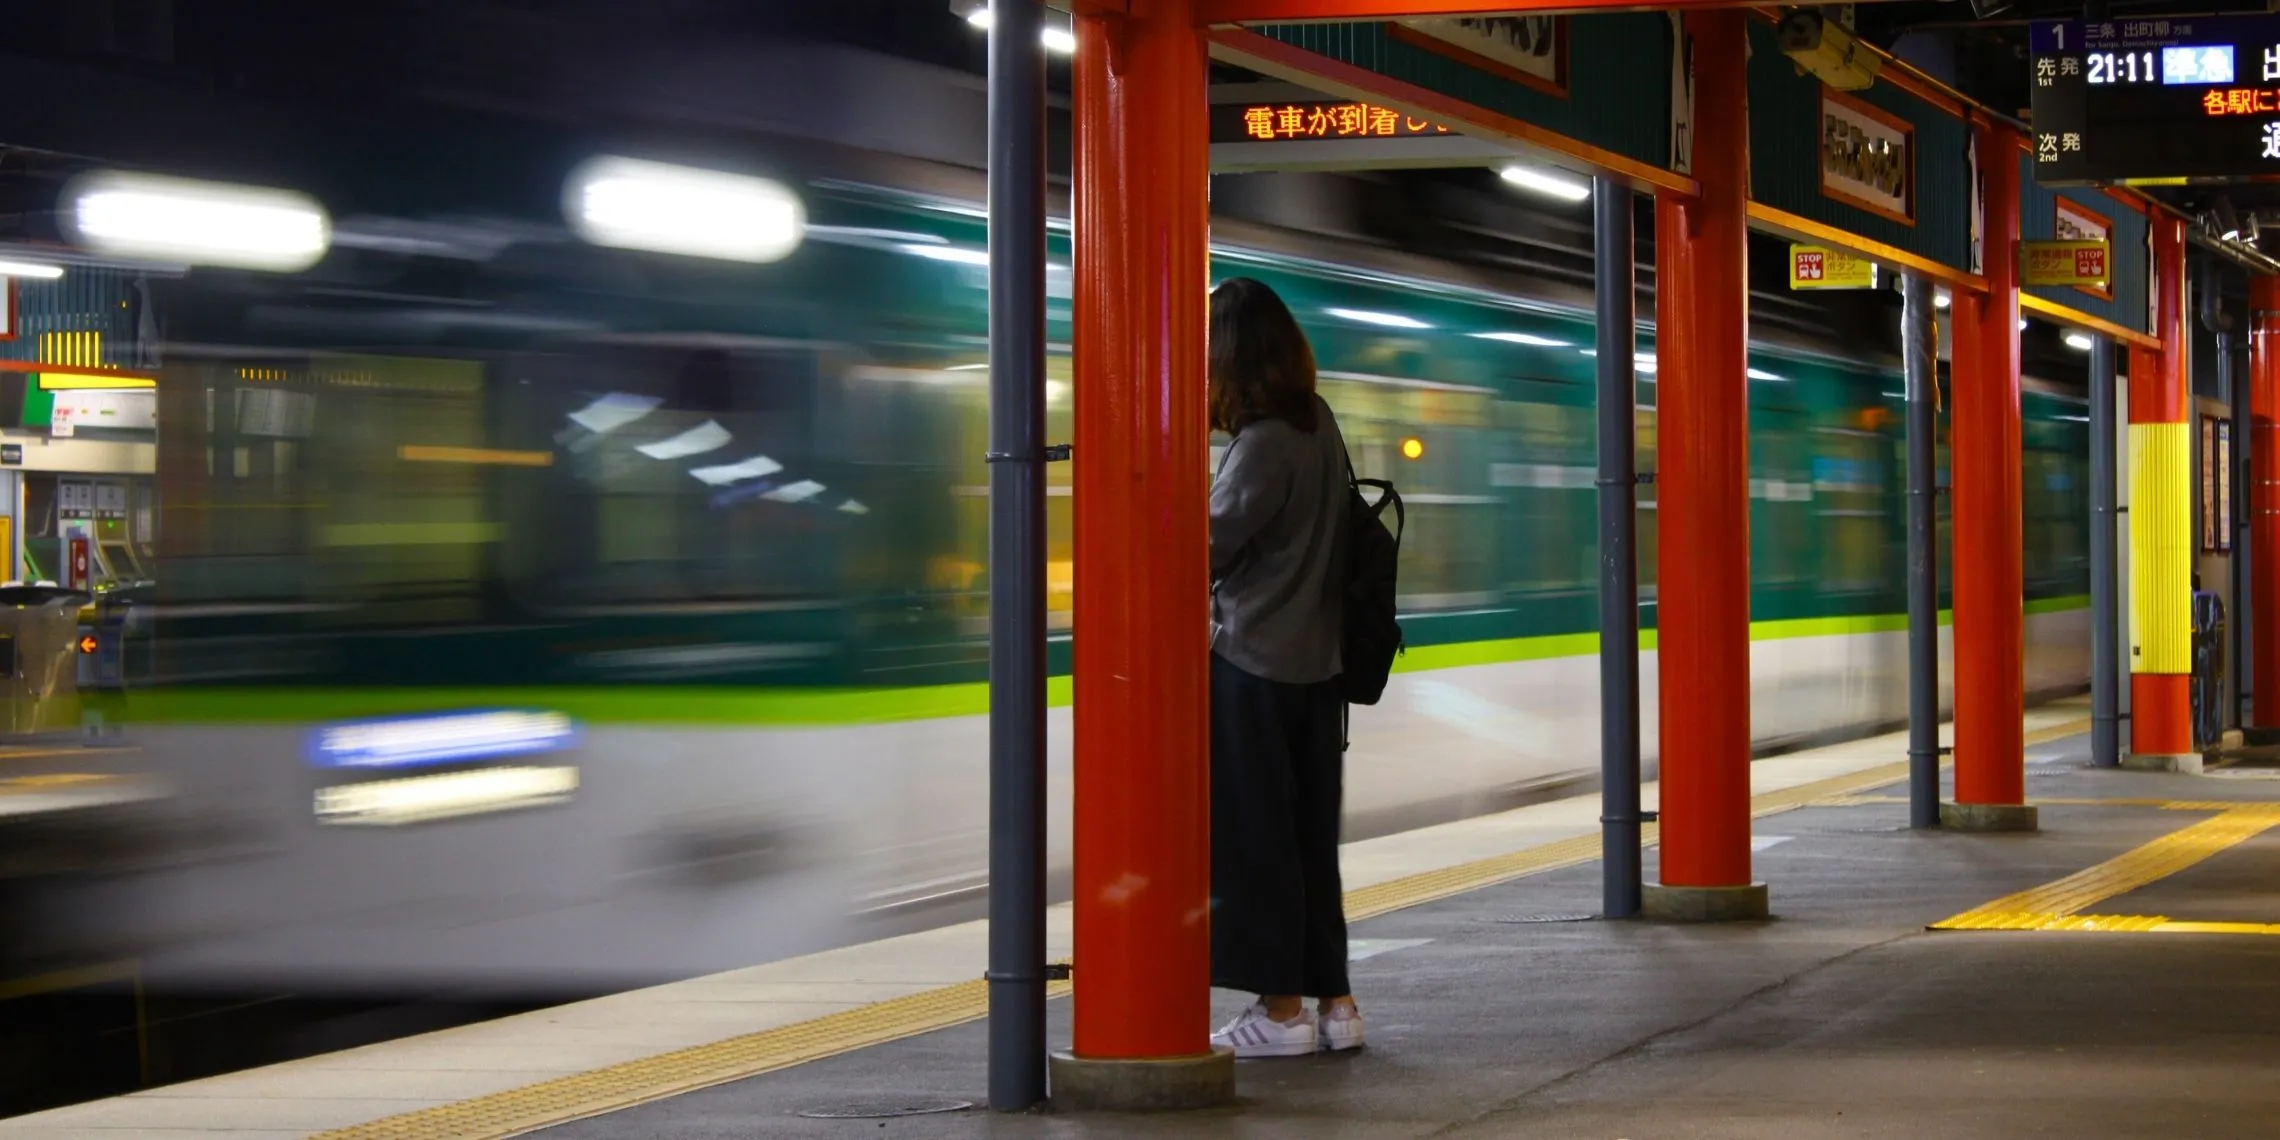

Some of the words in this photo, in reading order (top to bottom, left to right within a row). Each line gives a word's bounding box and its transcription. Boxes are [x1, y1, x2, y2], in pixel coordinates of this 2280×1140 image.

[2052, 24, 2064, 50] 1
[2085, 23, 2115, 39] 三条
[2124, 21, 2169, 37] 出町柳
[2037, 57, 2079, 76] 先発
[2087, 52, 2154, 84] 21:11
[2038, 77, 2052, 87] 1st
[2203, 89, 2280, 115] 各駅に
[2039, 132, 2081, 152] 次発
[2039, 153, 2058, 162] 2nd
[1797, 254, 1822, 263] STOP
[2077, 250, 2103, 259] STOP
